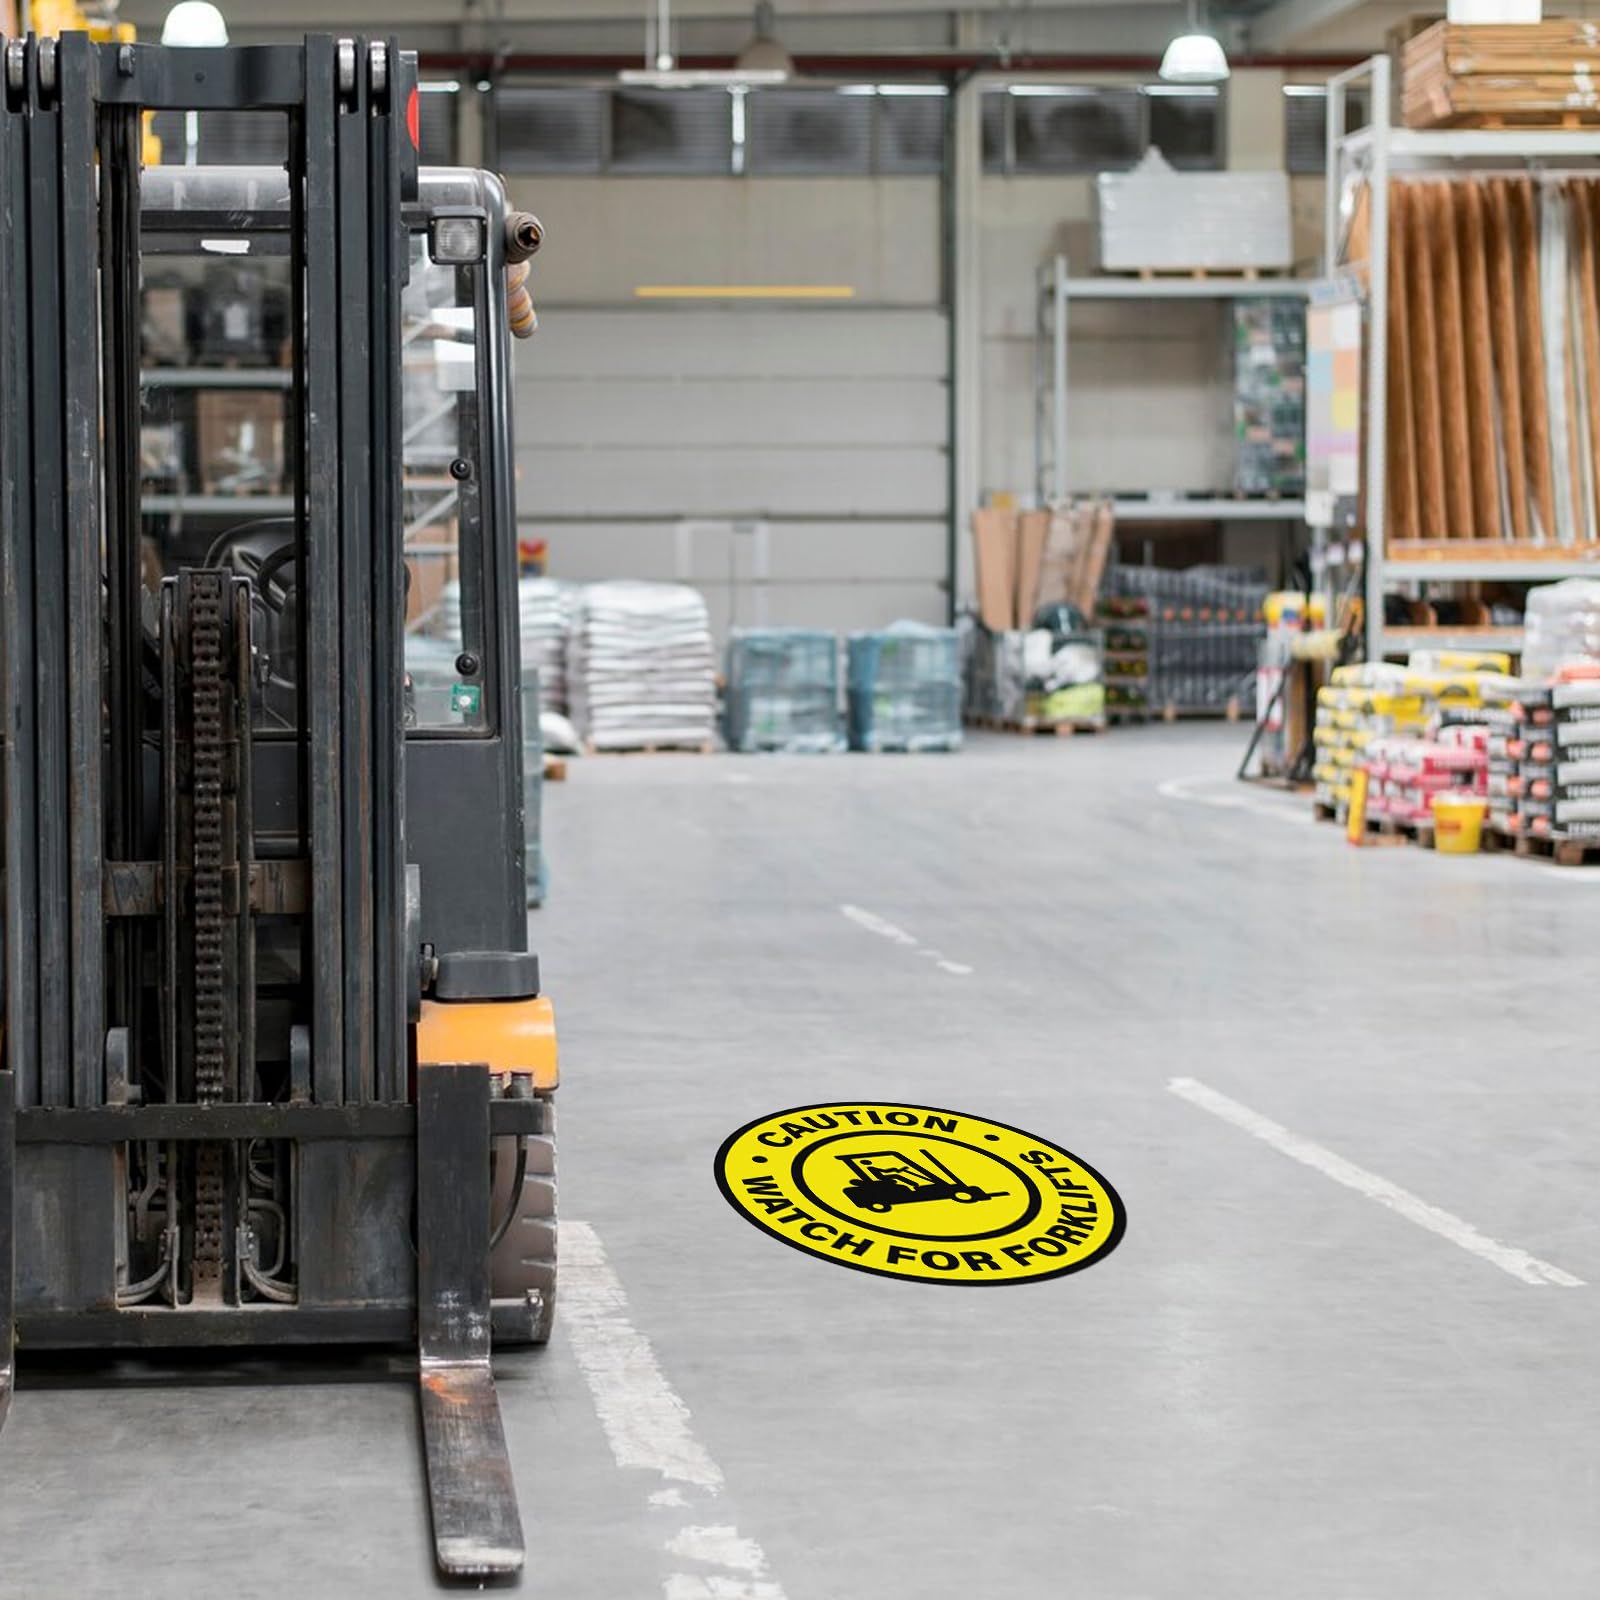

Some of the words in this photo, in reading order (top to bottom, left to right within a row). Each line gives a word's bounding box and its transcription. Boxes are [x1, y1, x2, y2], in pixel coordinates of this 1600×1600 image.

[758, 1110, 959, 1148] CAUTION
[741, 1175, 875, 1257] WATCH
[886, 1244, 1003, 1272] FOR
[999, 1150, 1098, 1267] FORKLIFTS
